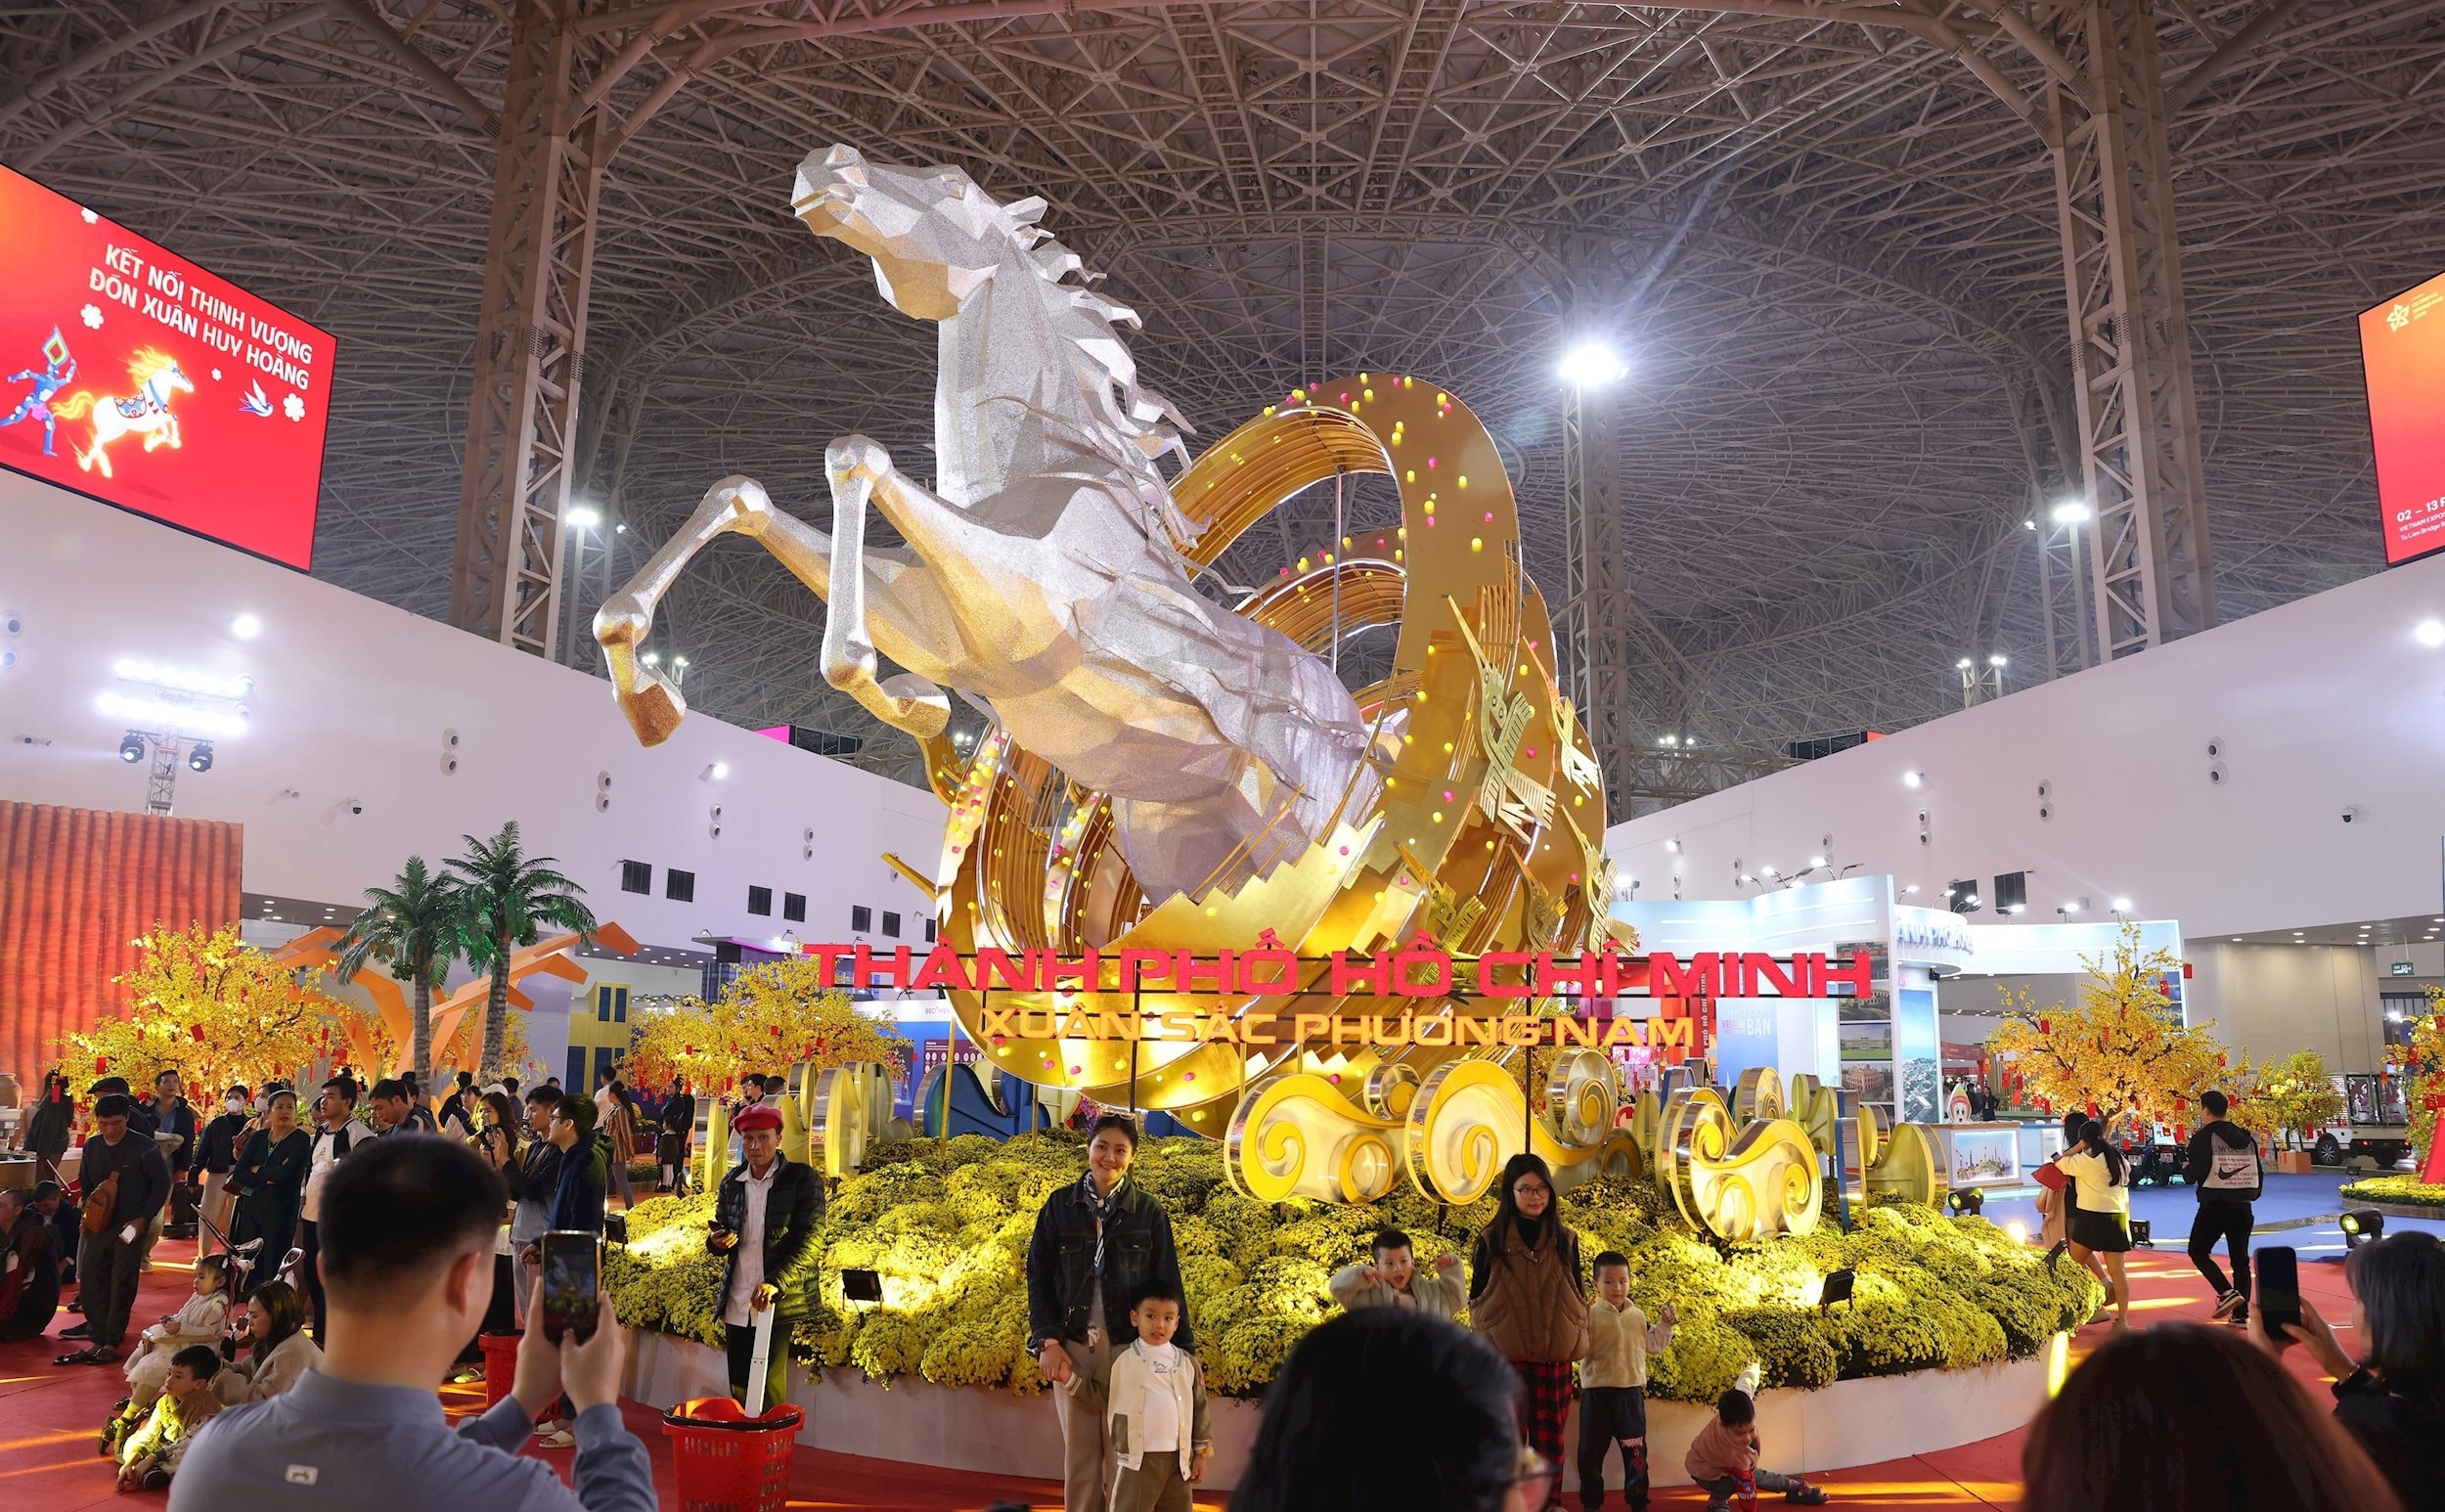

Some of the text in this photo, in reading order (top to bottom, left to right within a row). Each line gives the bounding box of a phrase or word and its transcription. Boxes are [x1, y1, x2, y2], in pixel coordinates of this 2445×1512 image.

[105, 243, 313, 365] KẾT NỐI THỊNH VƯỢNG
[141, 293, 199, 337] XUÂN
[201, 323, 244, 357] HUY
[245, 343, 310, 390] HOÀNG
[2397, 510, 2413, 522] 02
[2425, 500, 2438, 512] 13
[802, 927, 1873, 1000] THÀNH PHỐ HỒ CHÍ MINH
[982, 1000, 1694, 1047] XUÂN SẮC PHƯƠNG NAM
[1748, 1018, 1771, 1038] BẠN
